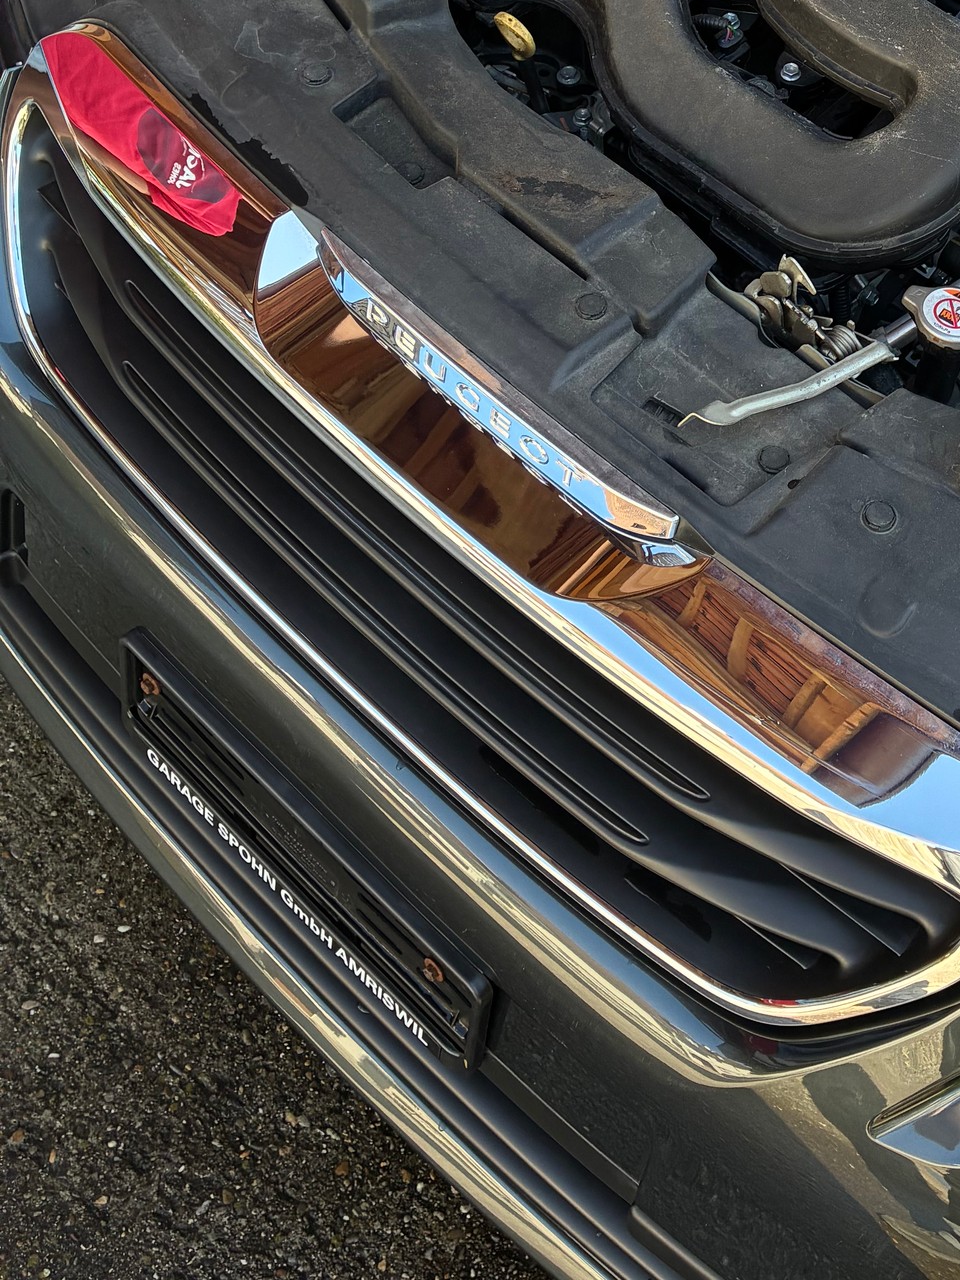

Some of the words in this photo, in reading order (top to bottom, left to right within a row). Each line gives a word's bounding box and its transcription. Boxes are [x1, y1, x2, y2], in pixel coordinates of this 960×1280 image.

[365, 297, 584, 487] PEUGEOT
[146, 748, 215, 828] GARAGE
[217, 823, 277, 891] SPOHN
[280, 888, 334, 949] GmbH
[335, 947, 429, 1047] AMRISWIL
